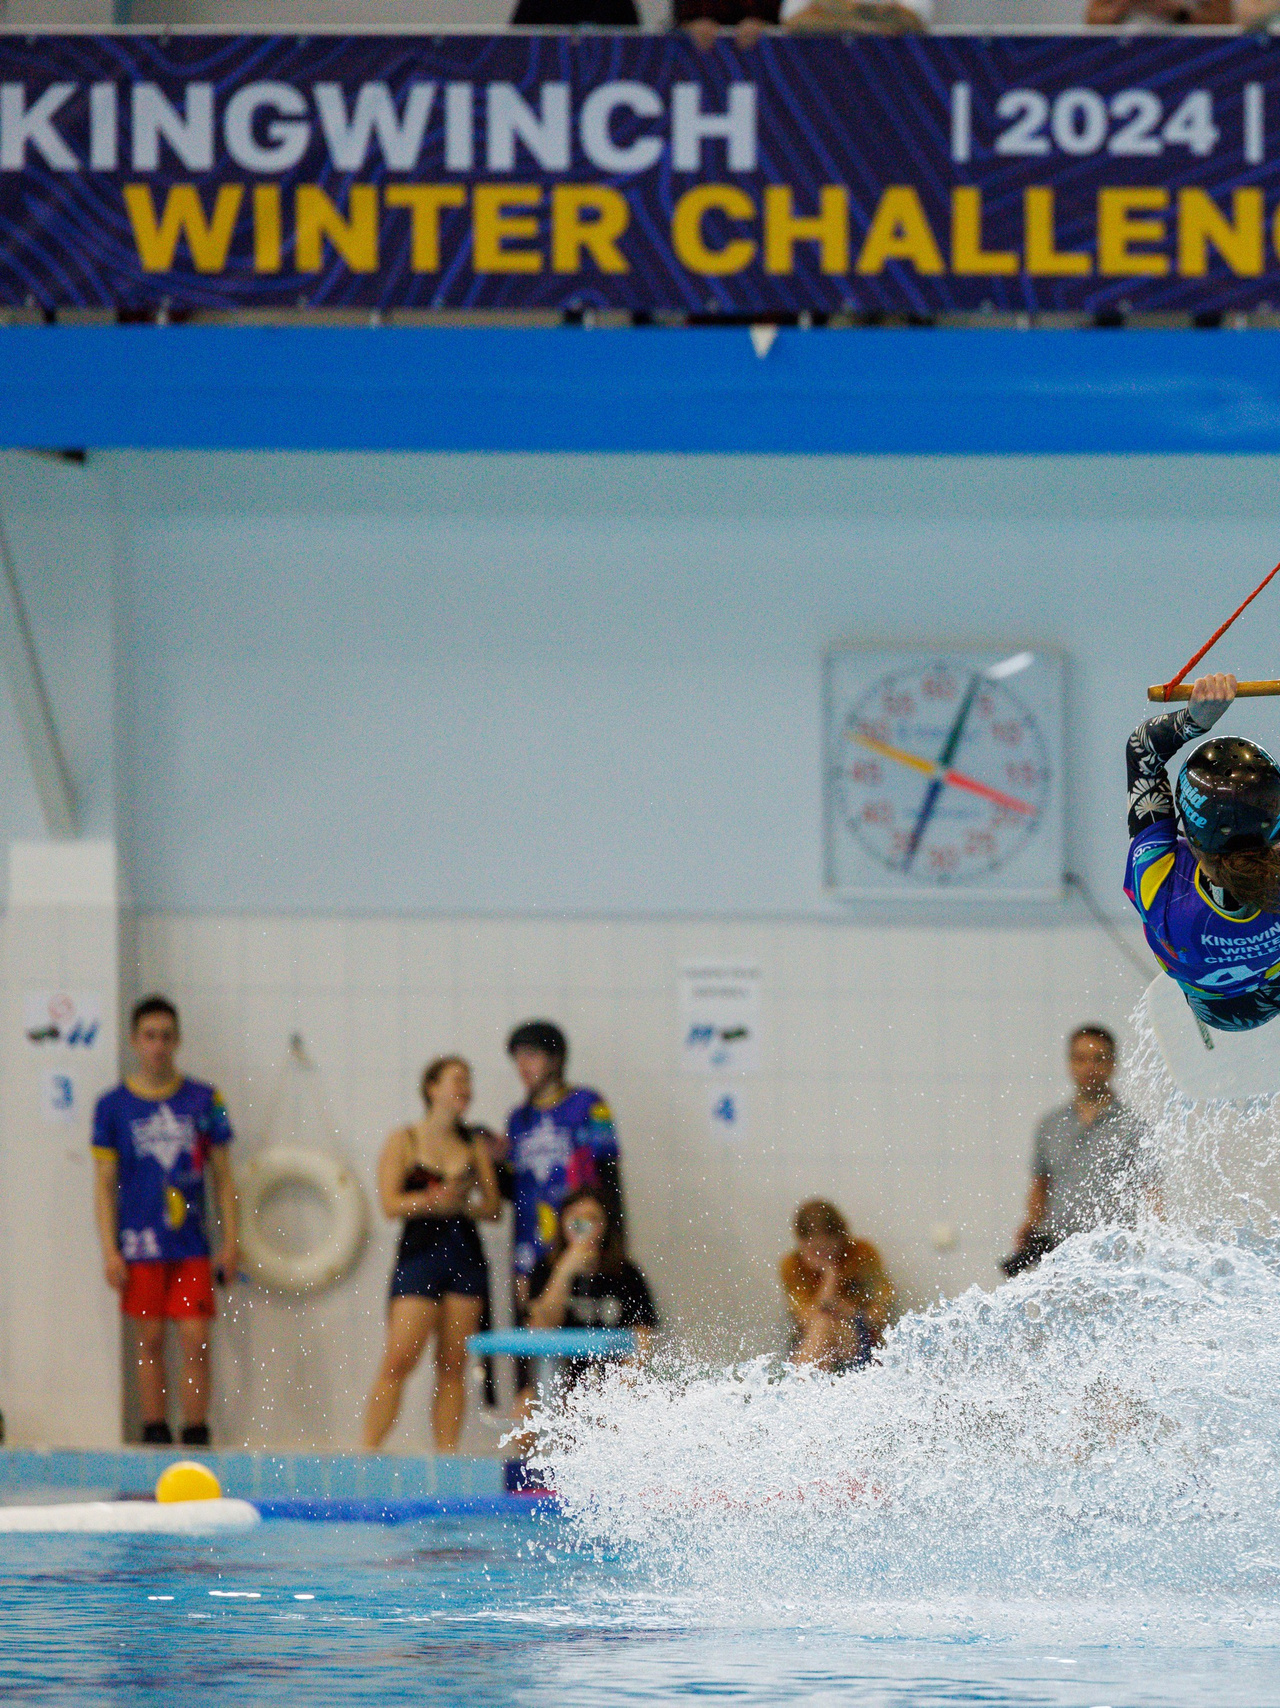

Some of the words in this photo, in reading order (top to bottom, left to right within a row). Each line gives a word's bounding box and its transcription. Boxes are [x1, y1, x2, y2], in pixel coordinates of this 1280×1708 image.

[0, 81, 759, 174] KINGWINCH
[995, 88, 1220, 157] 2024
[123, 182, 631, 275] WINTER
[51, 1074, 74, 1110] 3
[712, 1093, 738, 1125] 4
